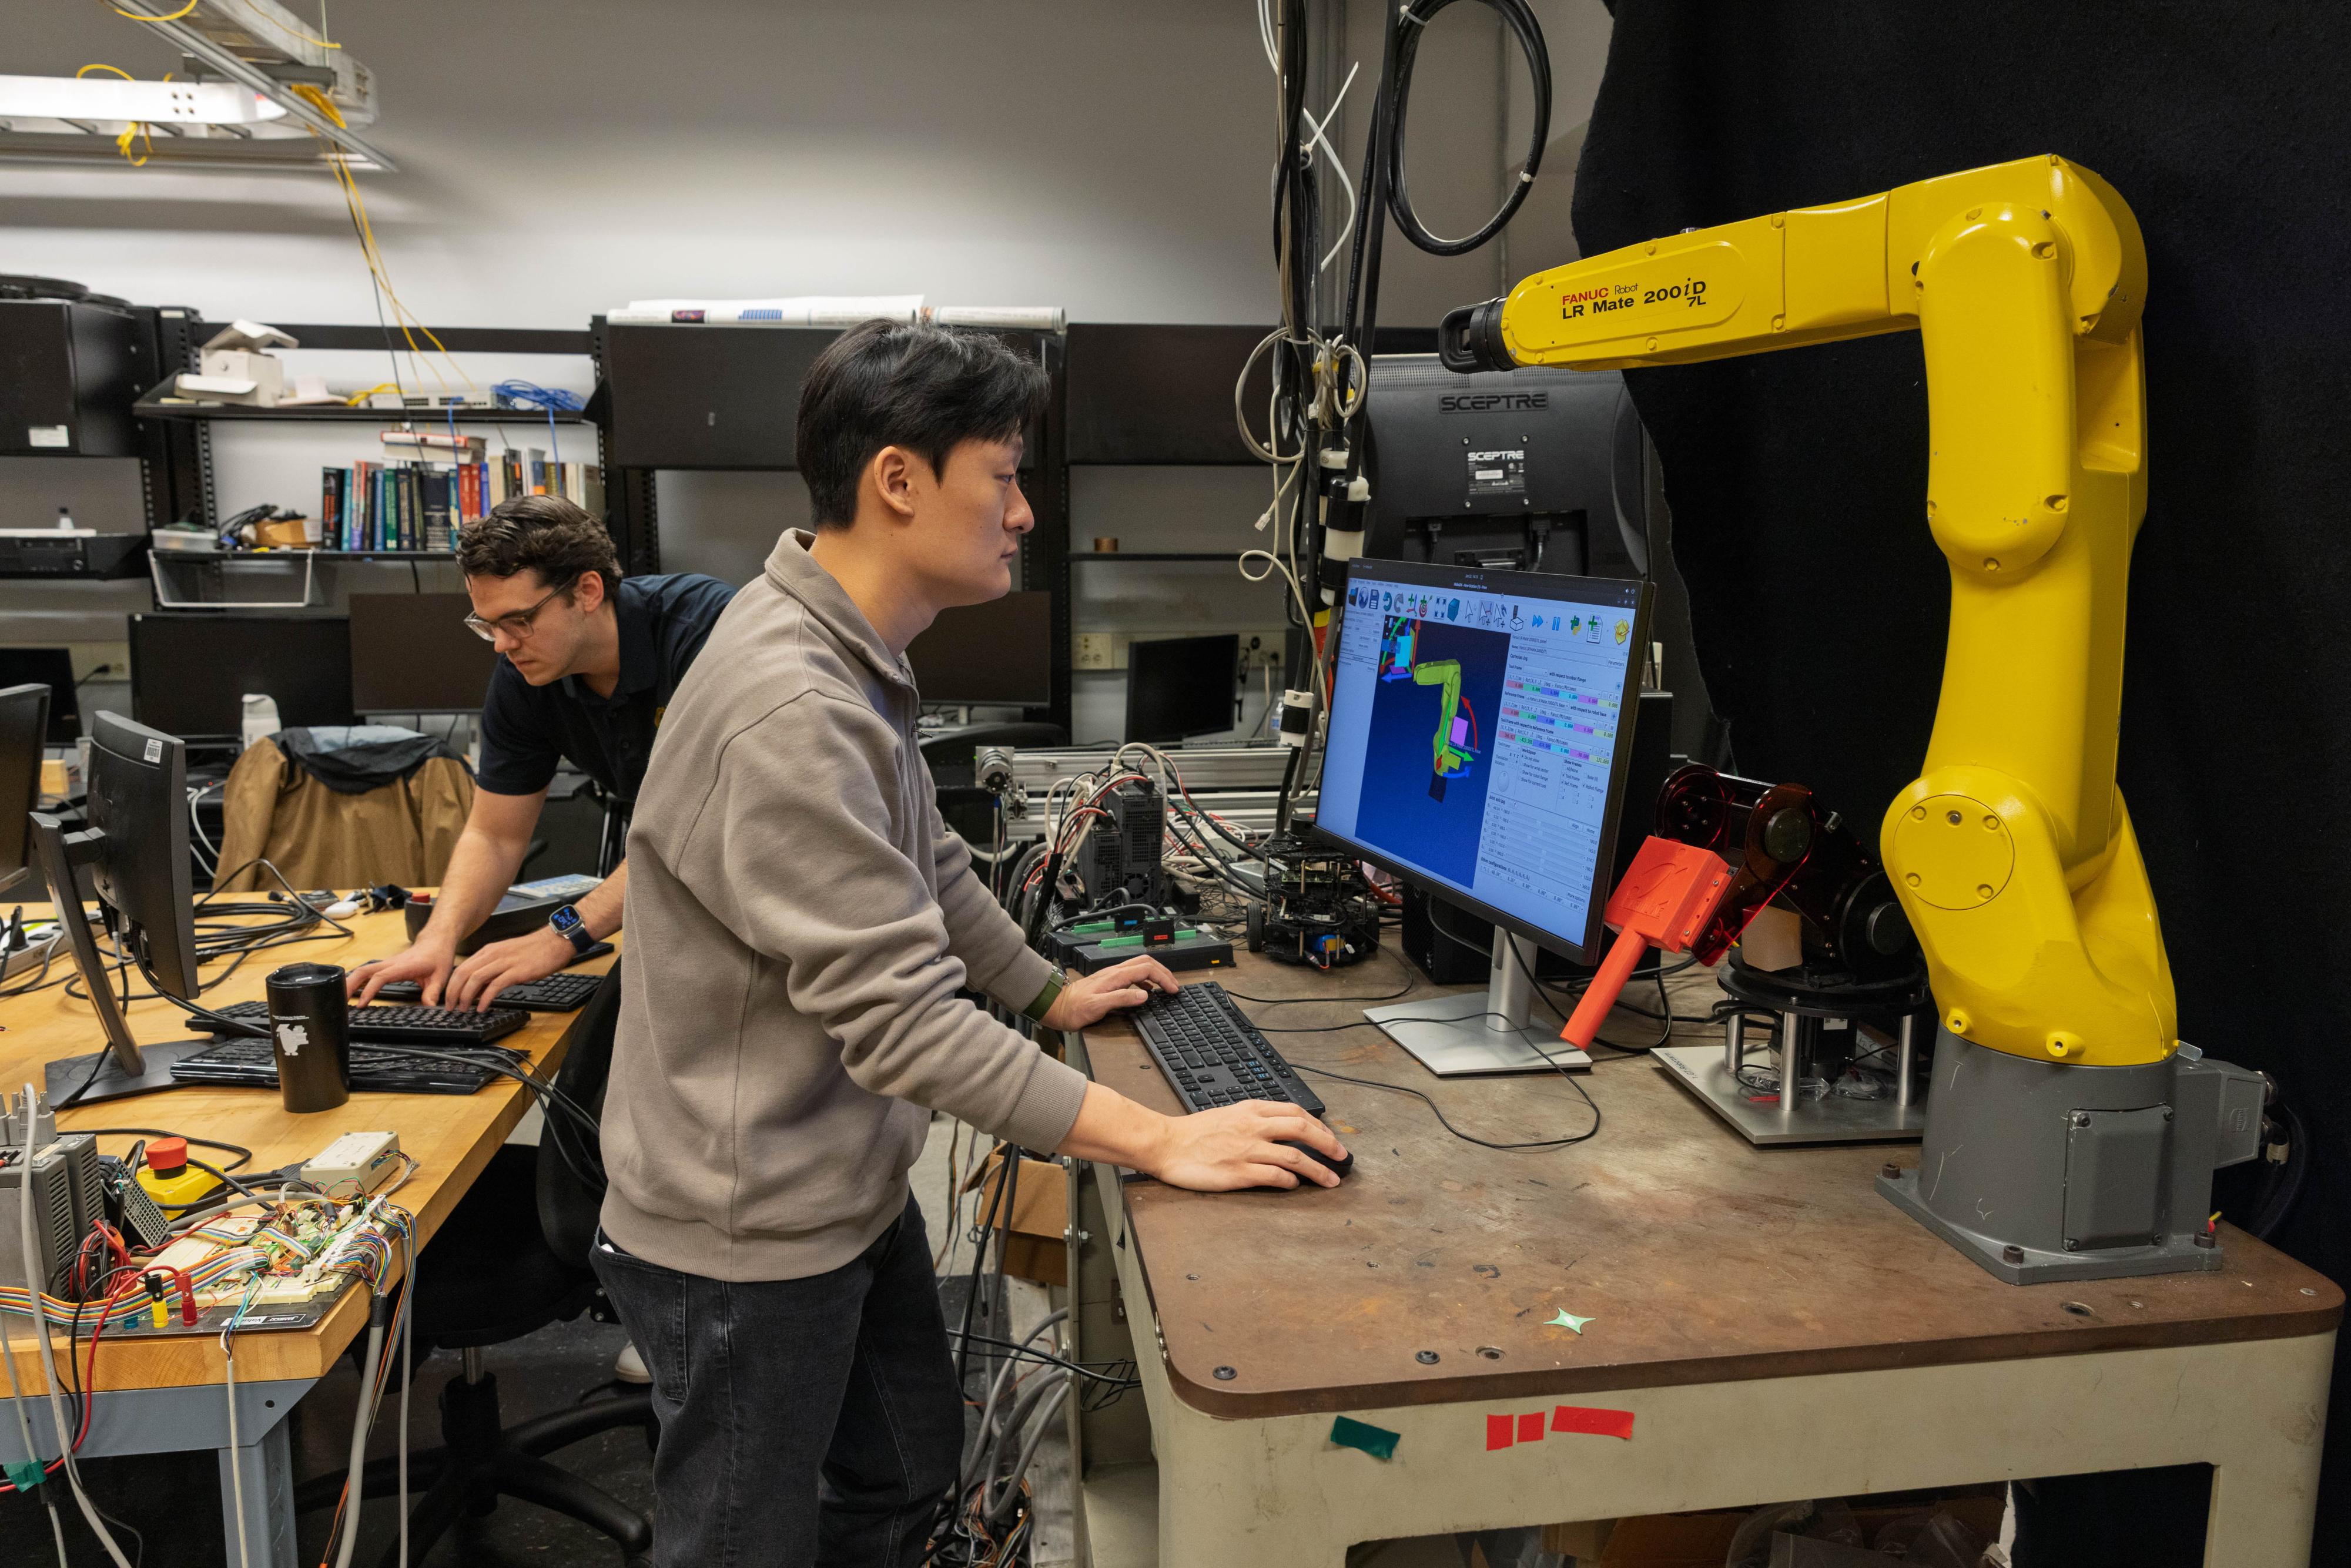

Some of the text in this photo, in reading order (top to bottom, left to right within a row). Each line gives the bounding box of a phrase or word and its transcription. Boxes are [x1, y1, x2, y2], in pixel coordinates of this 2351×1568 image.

[1562, 283, 1639, 306] FANUC Robot
[1686, 296, 1706, 307] 7L
[1562, 304, 1585, 320] LR
[1593, 296, 1635, 314] Mate
[1441, 393, 1547, 411] SCEPTRE
[1468, 450, 1524, 461] SCEPTRE
